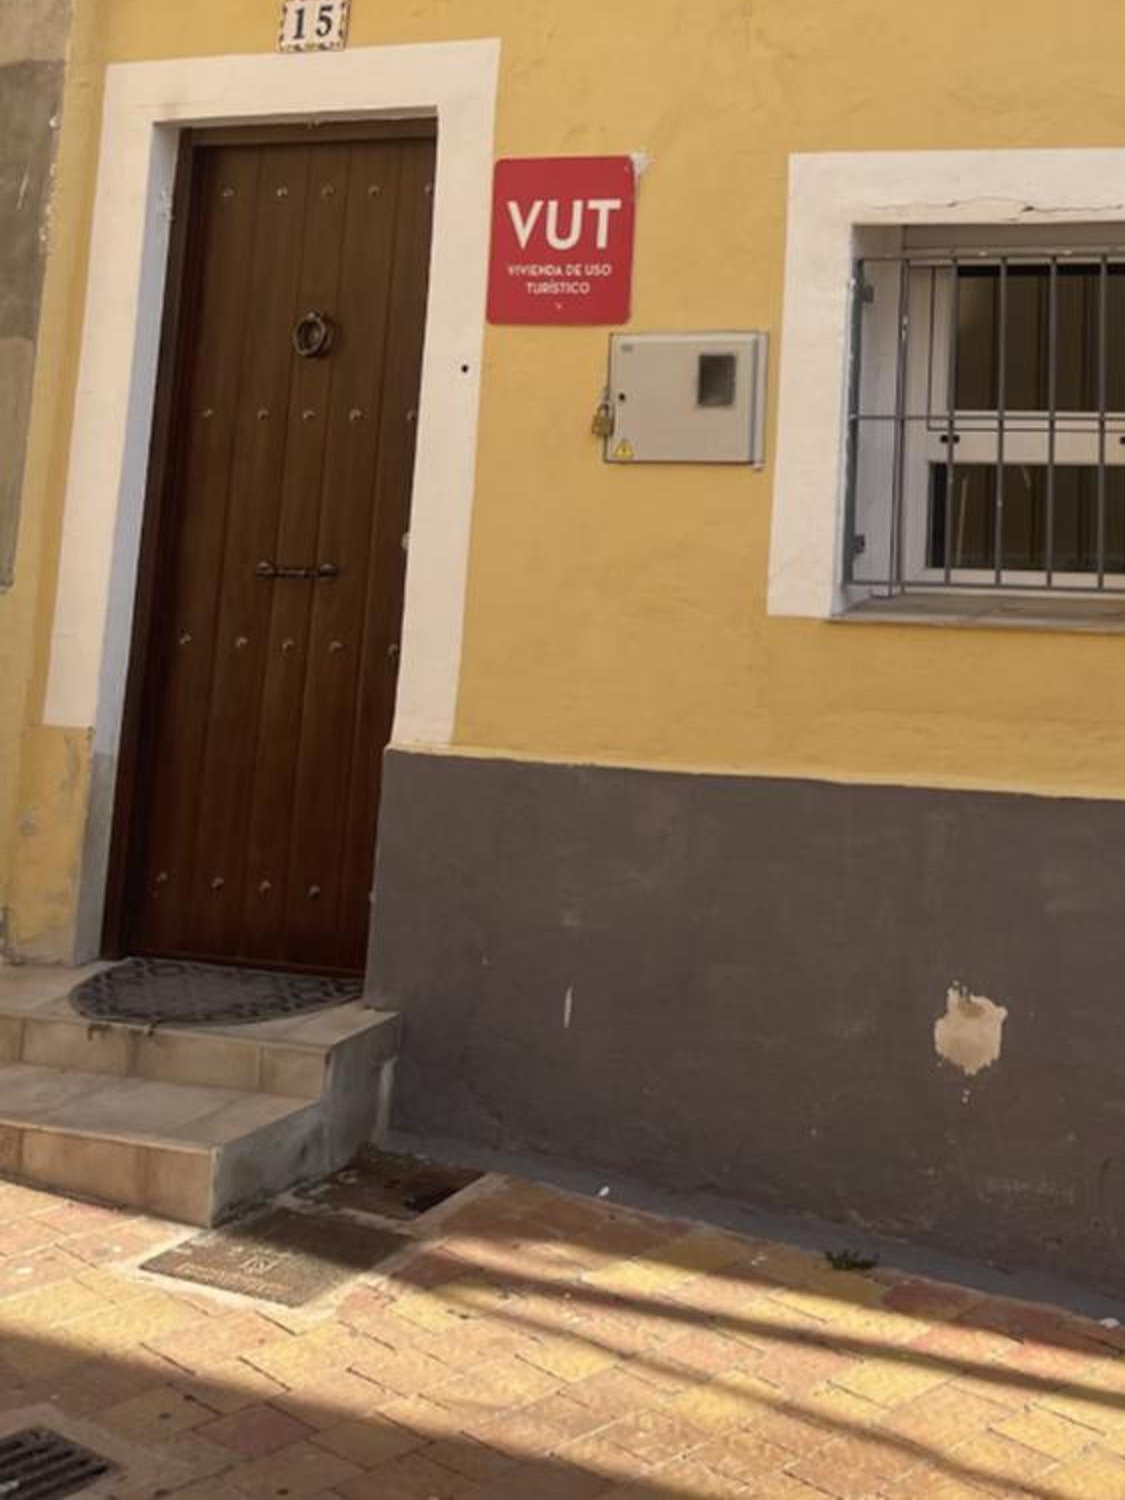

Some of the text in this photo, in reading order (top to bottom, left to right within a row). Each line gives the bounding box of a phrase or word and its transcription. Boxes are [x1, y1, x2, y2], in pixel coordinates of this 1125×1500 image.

[293, 4, 335, 40] 15
[507, 198, 622, 250] VUT
[508, 263, 612, 276] VIVIENDA DE USO
[526, 279, 591, 295] TURÍSTICO
